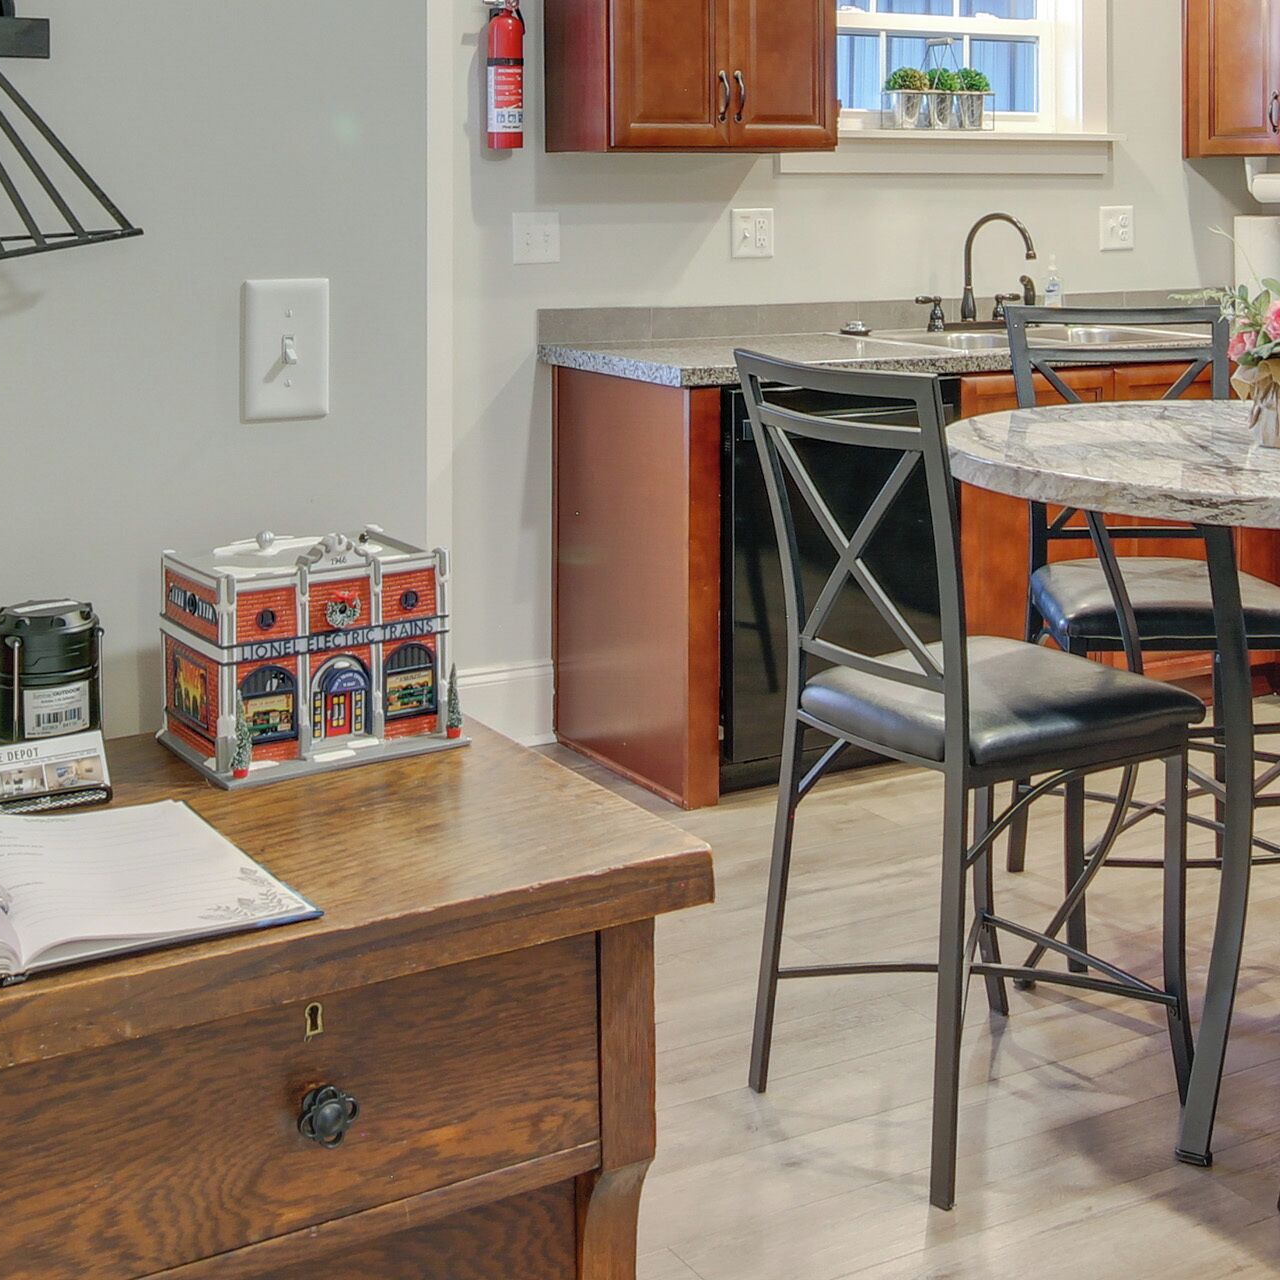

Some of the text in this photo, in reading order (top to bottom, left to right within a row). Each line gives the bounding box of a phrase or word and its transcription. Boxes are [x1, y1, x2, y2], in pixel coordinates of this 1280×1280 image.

[241, 619, 434, 661] LIONEL ELECTRIC TRAINS
[7, 747, 40, 762] DEPOT
